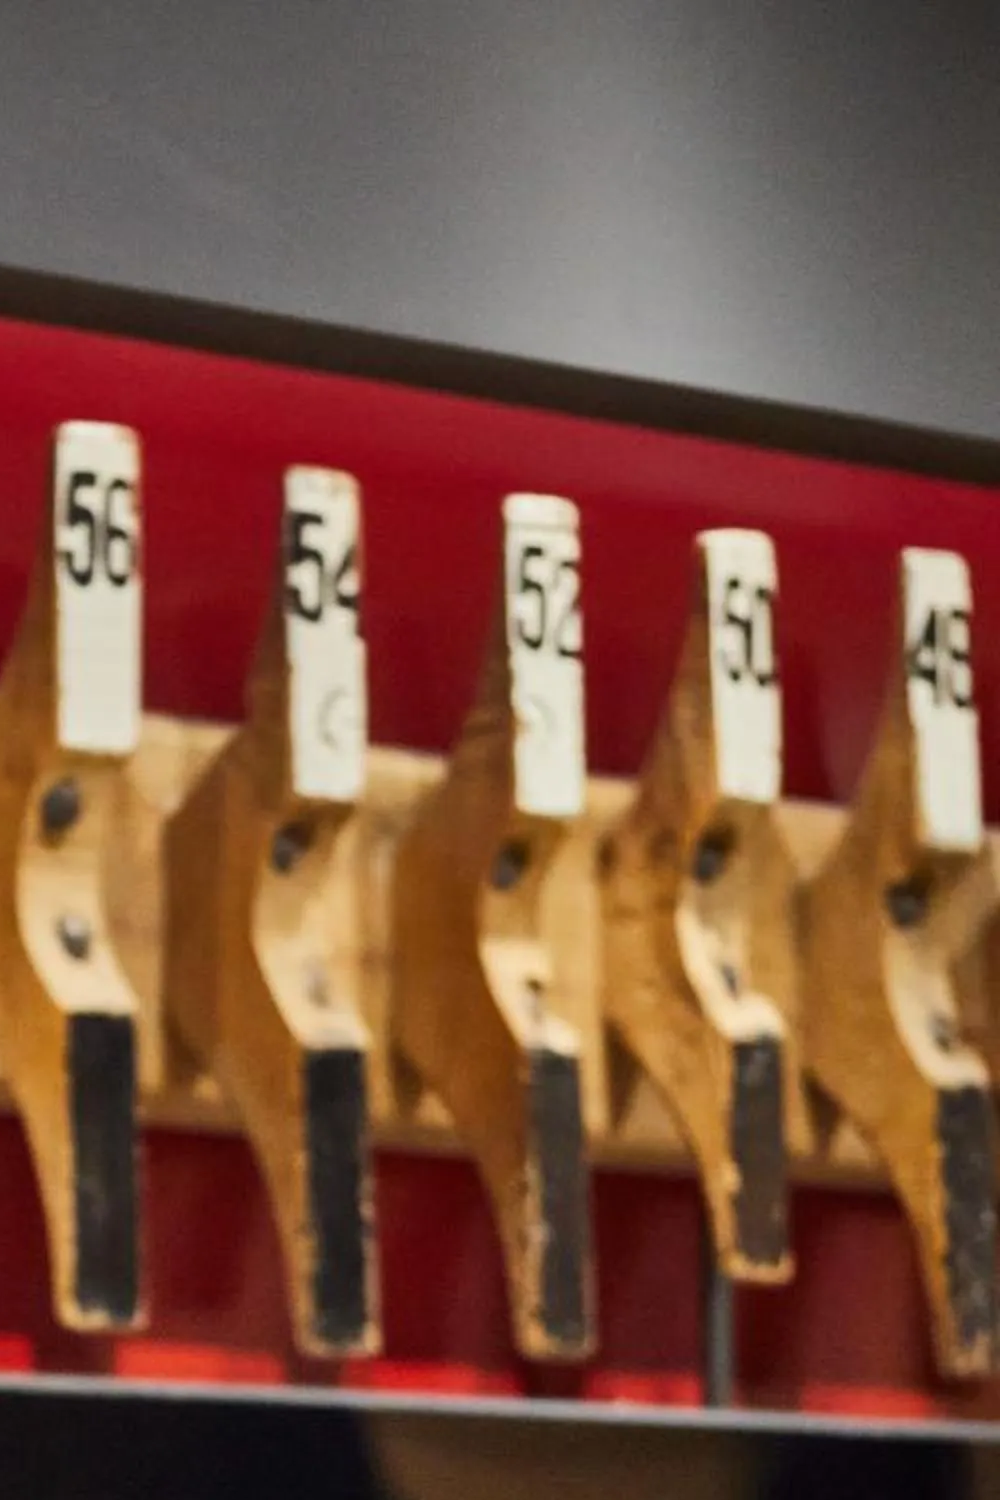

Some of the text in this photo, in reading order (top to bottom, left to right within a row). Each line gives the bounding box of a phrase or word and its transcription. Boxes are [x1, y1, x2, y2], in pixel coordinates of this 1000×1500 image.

[63, 470, 136, 588] 56
[285, 510, 359, 622] 54
[518, 545, 583, 658] 52
